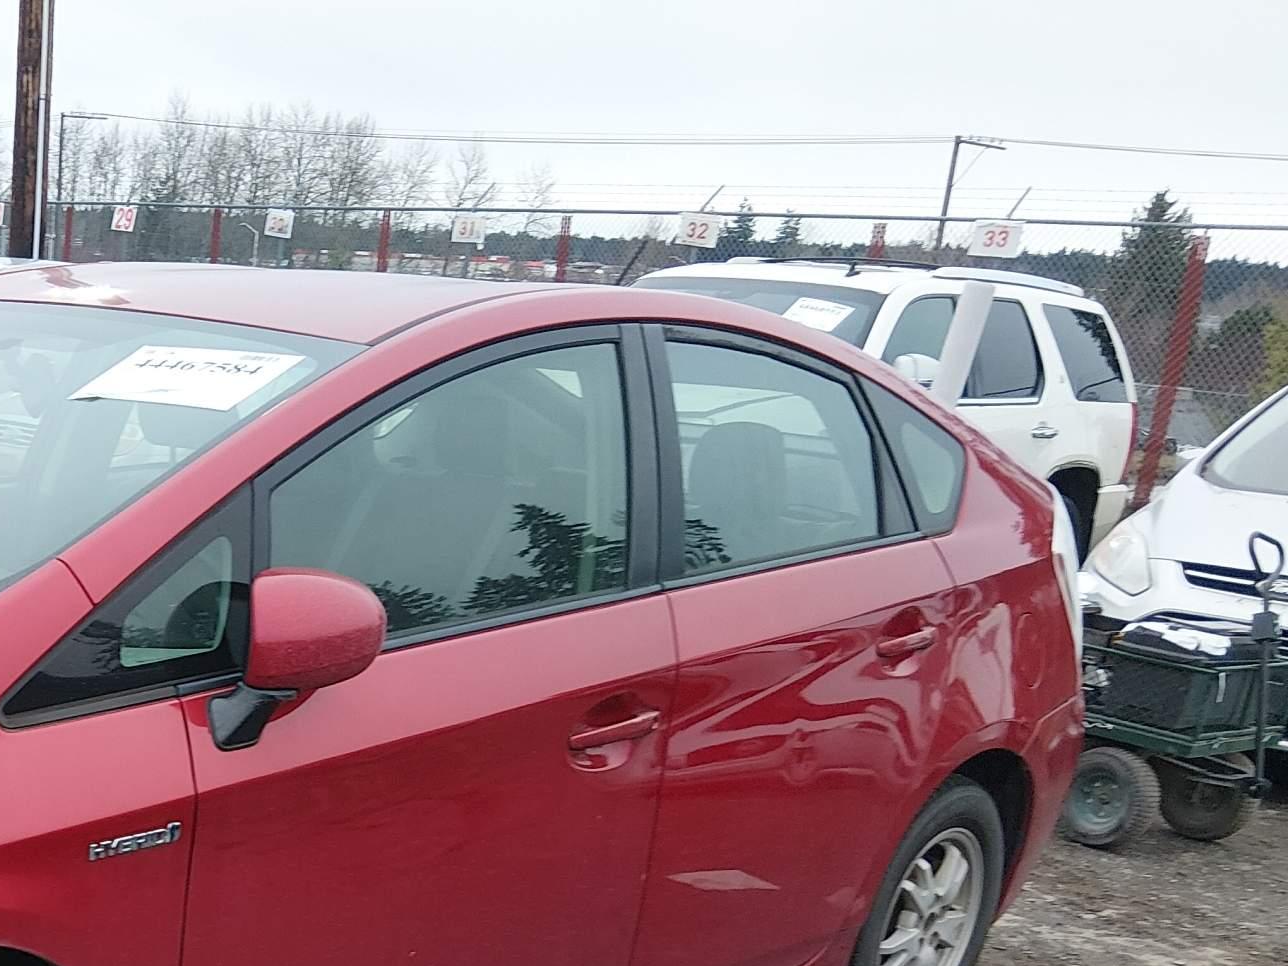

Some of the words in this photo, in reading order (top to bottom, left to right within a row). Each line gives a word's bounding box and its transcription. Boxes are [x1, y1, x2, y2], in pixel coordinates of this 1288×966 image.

[114, 207, 133, 231] 29
[458, 221, 476, 236] 31
[686, 221, 709, 240] 32
[983, 230, 1009, 248] 33
[88, 822, 182, 861] HYBRID
